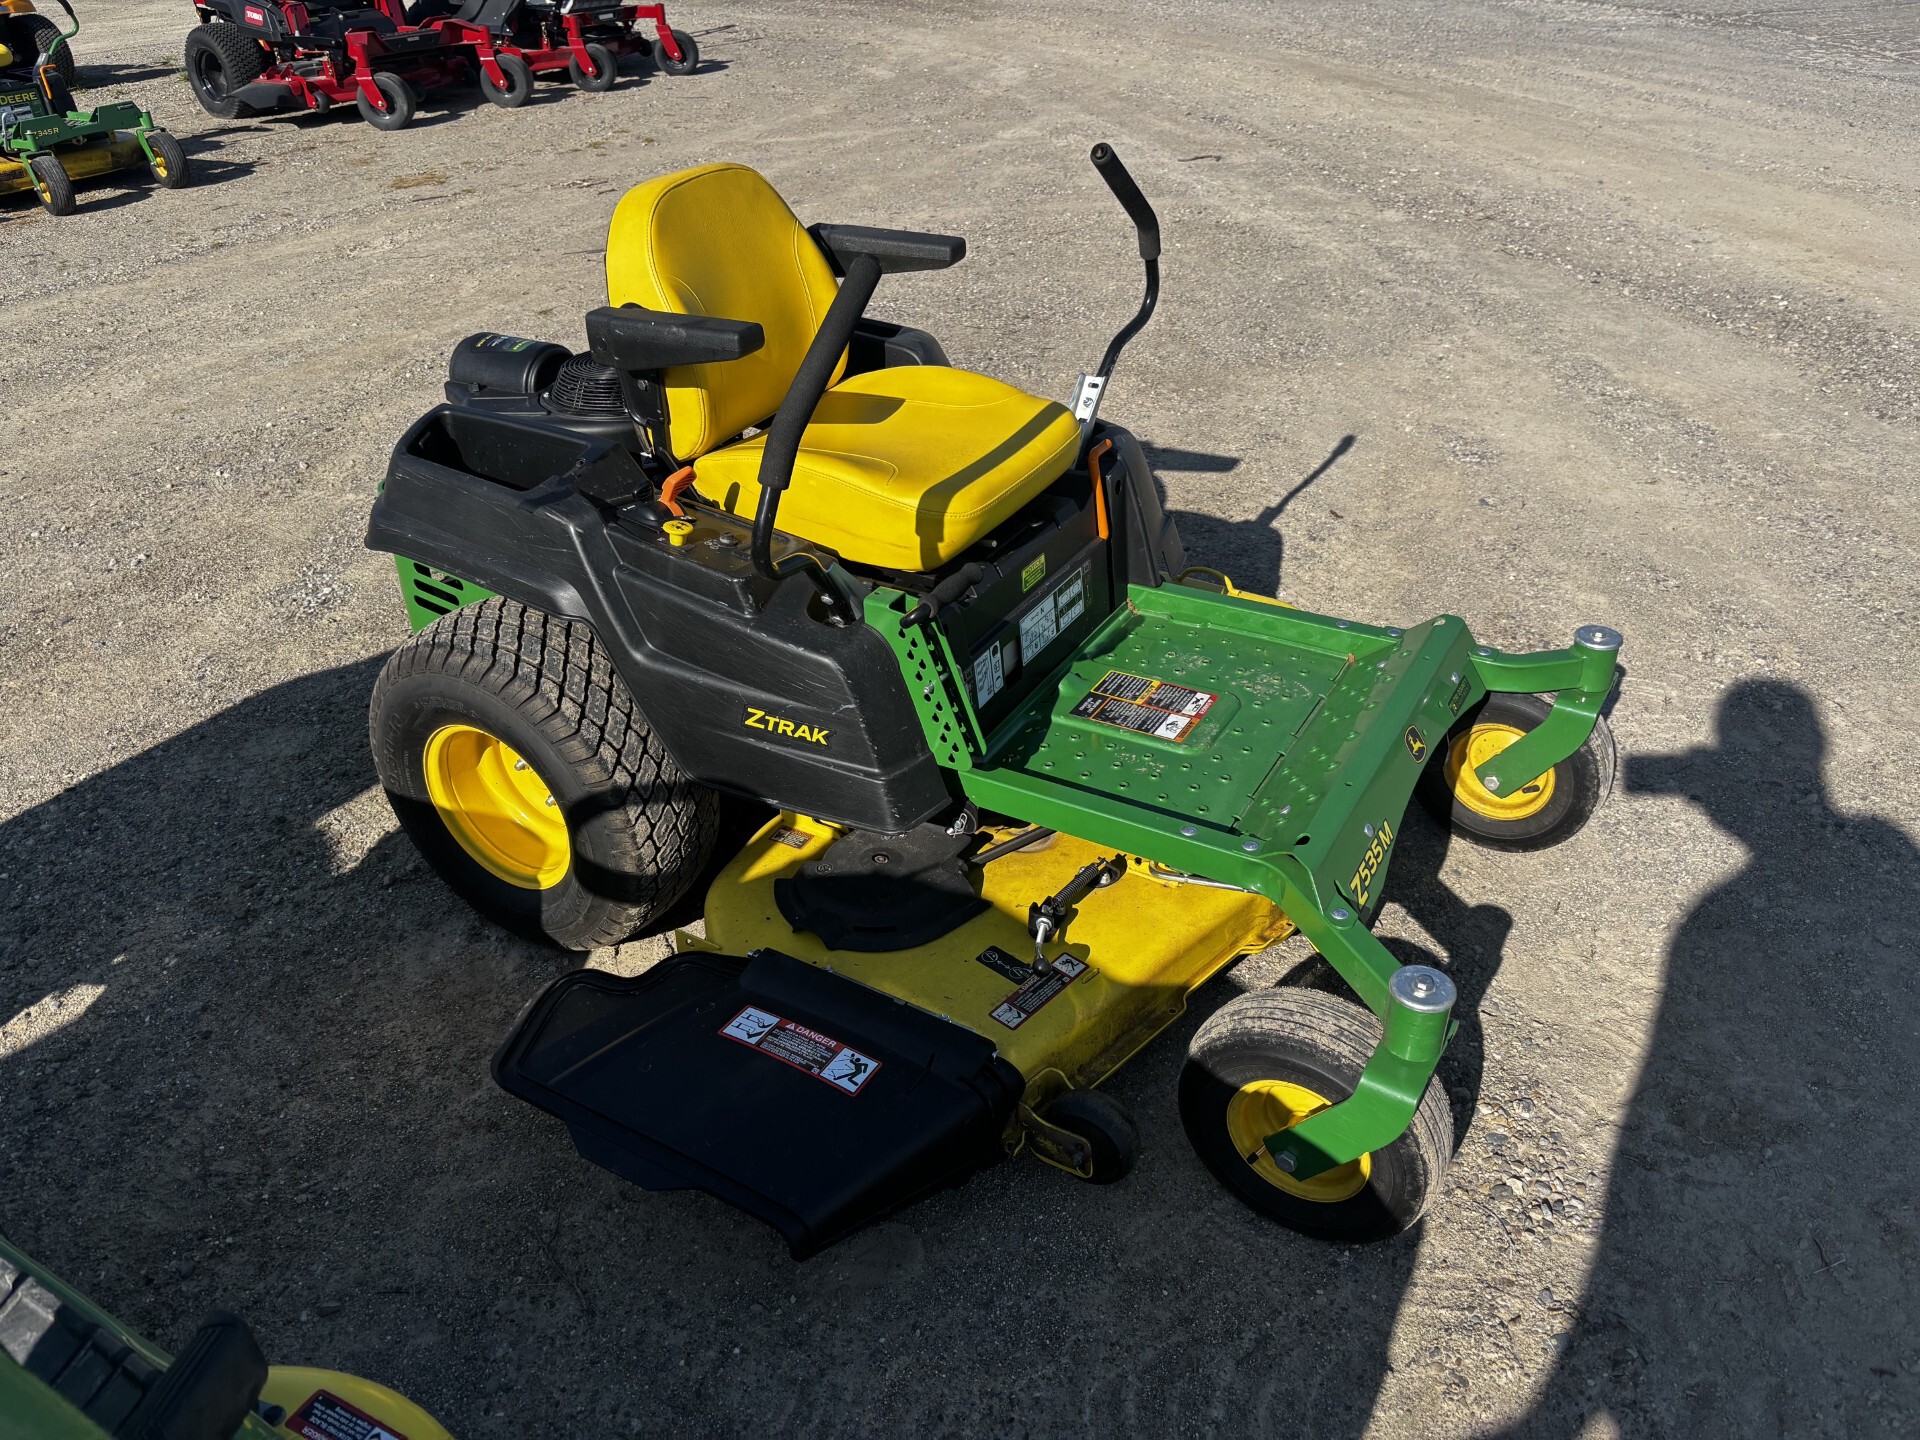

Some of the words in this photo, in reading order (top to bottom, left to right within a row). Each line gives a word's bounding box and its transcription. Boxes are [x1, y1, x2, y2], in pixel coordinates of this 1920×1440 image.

[246, 11, 263, 21] TORO
[0, 91, 38, 106] DEERE
[745, 707, 829, 745] ZTRAK
[1350, 819, 1394, 907] Z535M
[795, 1025, 836, 1047] DANGER
